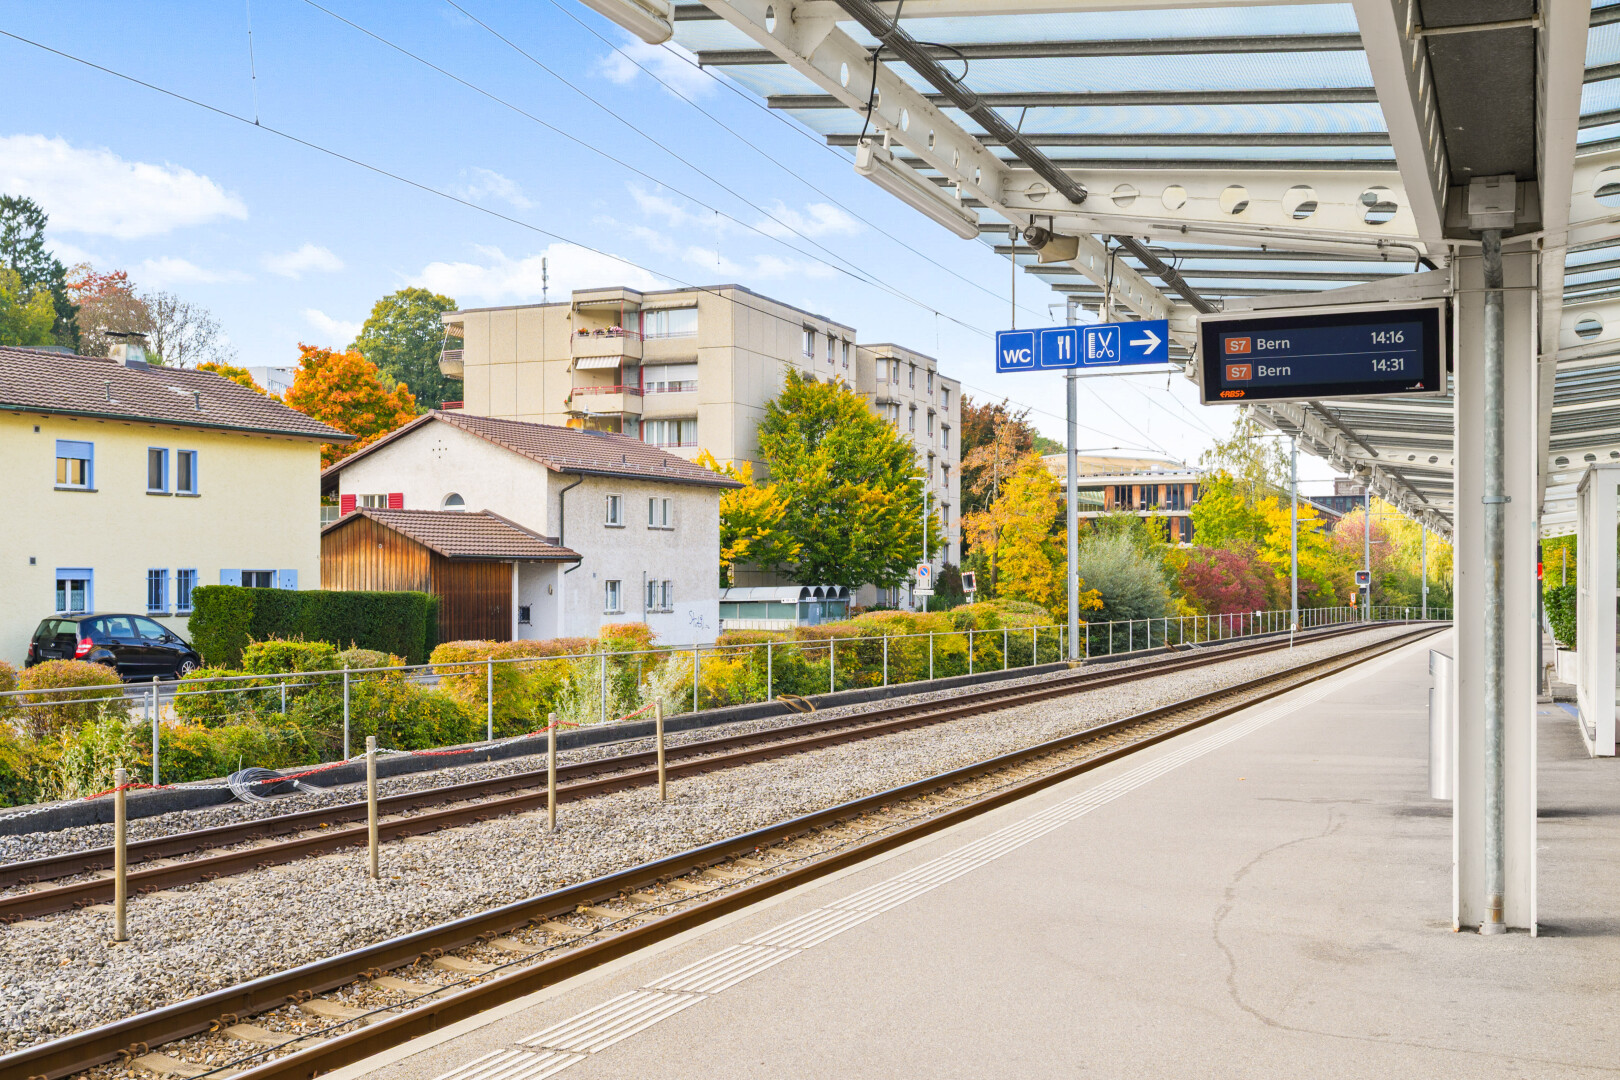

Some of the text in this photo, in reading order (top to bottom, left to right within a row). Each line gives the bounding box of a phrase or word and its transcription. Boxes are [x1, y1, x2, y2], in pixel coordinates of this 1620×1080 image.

[1230, 331, 1404, 351] S7 Bern 14:16
[1003, 349, 1031, 363] WC
[1231, 358, 1404, 377] S7 Bern 14:31
